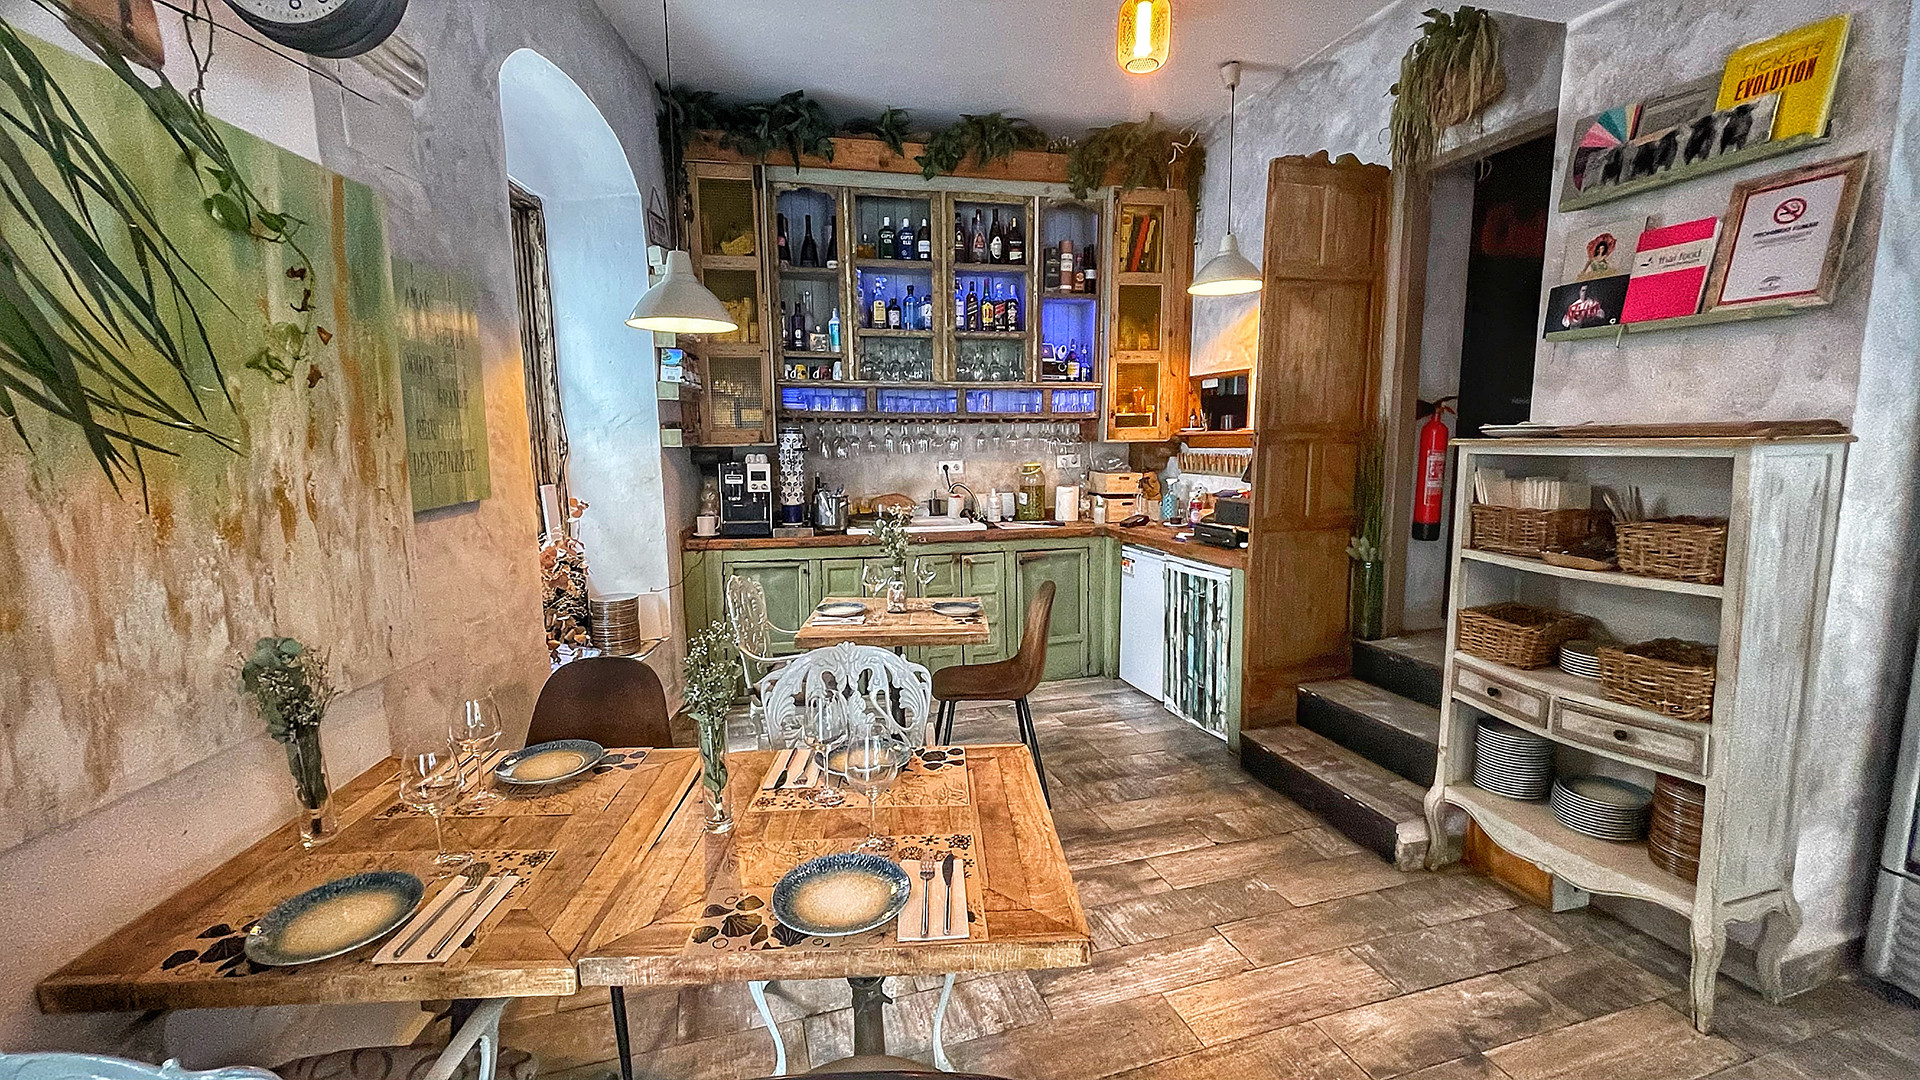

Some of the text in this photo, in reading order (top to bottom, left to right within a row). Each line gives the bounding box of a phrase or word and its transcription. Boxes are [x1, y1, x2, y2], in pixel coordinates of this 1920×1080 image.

[1743, 40, 1825, 77] TICKETS
[1734, 55, 1819, 101] EVOLUTION
[1679, 248, 1702, 260] food
[413, 449, 476, 477] DESPEINARTE
